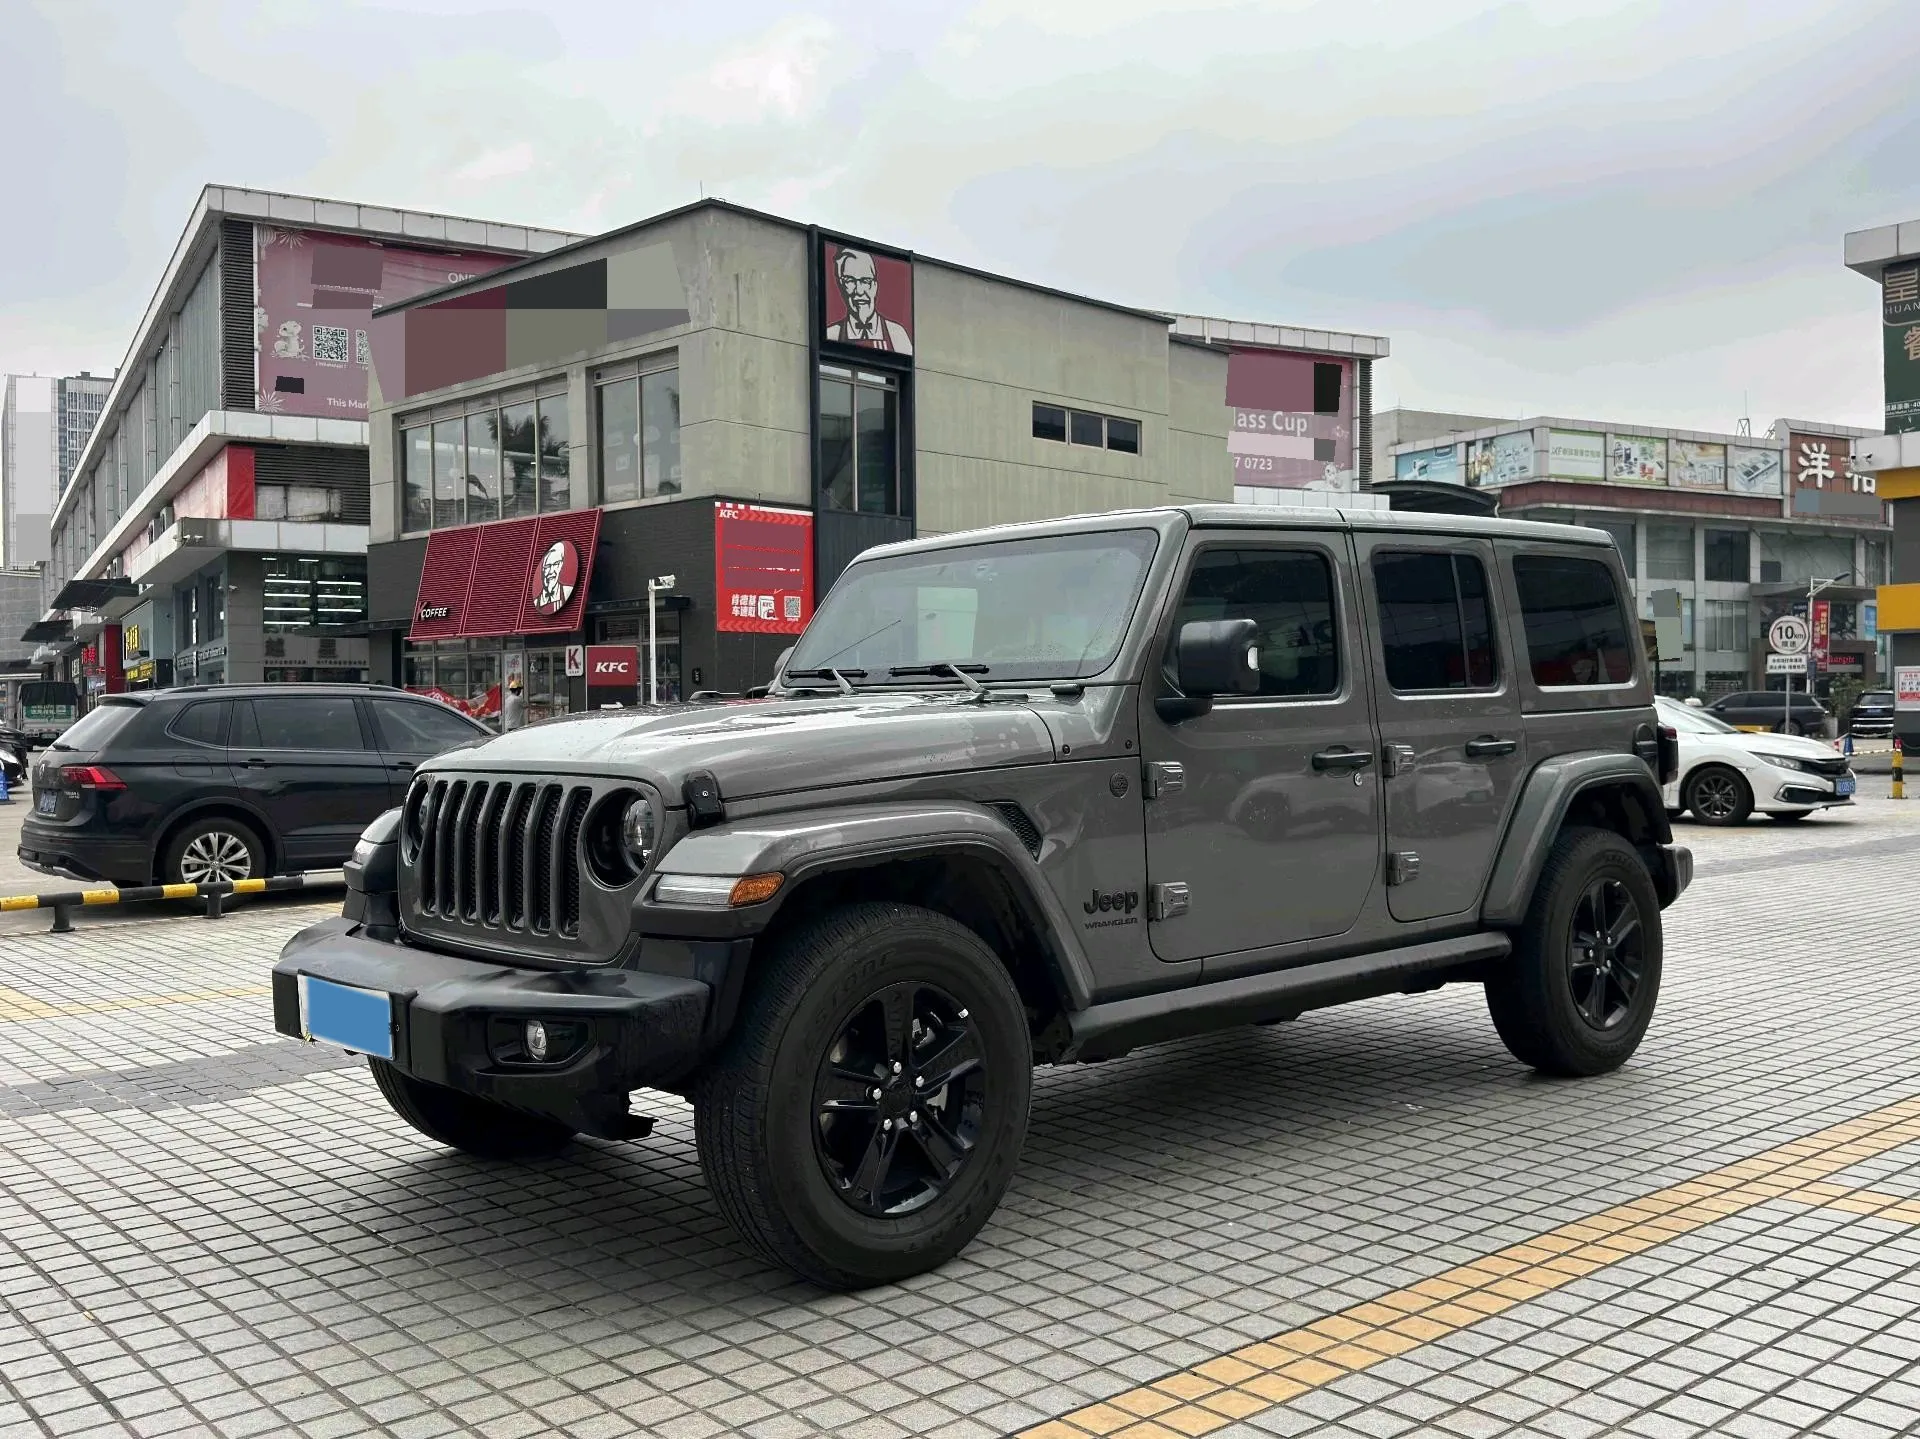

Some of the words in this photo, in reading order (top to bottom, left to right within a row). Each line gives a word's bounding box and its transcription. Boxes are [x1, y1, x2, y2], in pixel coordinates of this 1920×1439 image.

[1884, 268, 1919, 304] 皇
[326, 397, 347, 408] This
[1272, 411, 1308, 435] Cup
[1244, 457, 1273, 470] 0723
[719, 509, 739, 520] KFC
[421, 607, 448, 618] COFFEE
[568, 648, 580, 670] K
[595, 661, 629, 673] KFC
[1083, 889, 1139, 914] Jeep
[1084, 917, 1138, 930] WRANGLER
